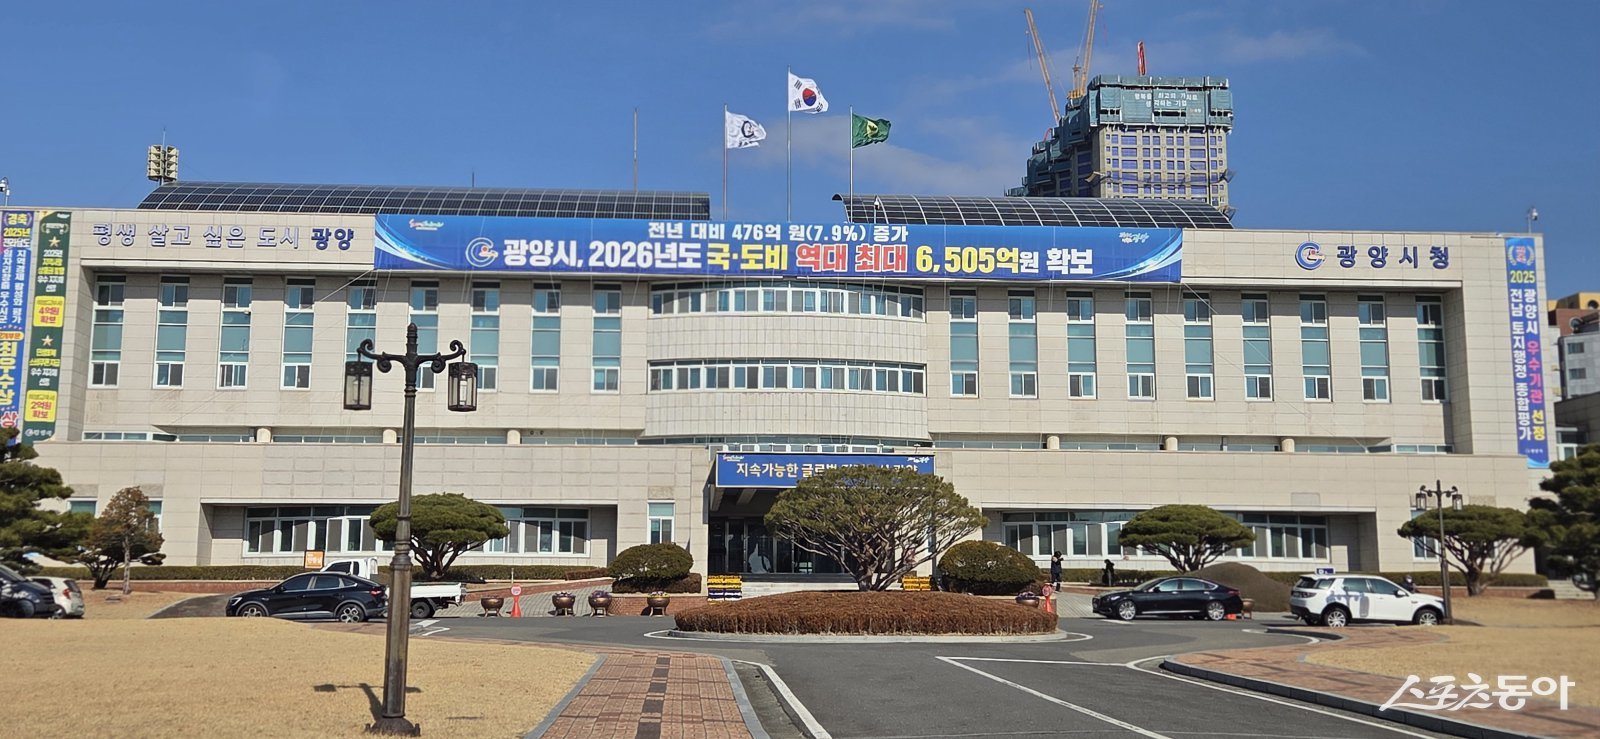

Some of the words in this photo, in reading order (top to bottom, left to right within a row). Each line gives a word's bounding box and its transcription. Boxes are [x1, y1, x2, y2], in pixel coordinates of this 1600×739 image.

[8, 213, 28, 225] 경축
[648, 222, 683, 239] 전년
[691, 223, 725, 240] 대비
[732, 224, 781, 241] 476억
[788, 225, 866, 242] 원(7.9%)
[873, 226, 908, 243] 증가
[92, 223, 137, 246] 평생
[148, 224, 191, 247] 살고
[203, 225, 246, 248] 싶은
[256, 226, 299, 249] 도시
[311, 227, 355, 251] 광양
[503, 239, 584, 268] 광양시,
[589, 240, 701, 269] 2026년도
[707, 243, 788, 271] 국·도비
[795, 243, 848, 272] 역대
[854, 244, 908, 273] 최대
[915, 245, 1039, 274] 6,505억원
[1046, 248, 1094, 275] 확보
[1337, 245, 1450, 270] 광양시청
[1510, 270, 1536, 283] 2025
[1510, 288, 1523, 317] 전남
[1524, 288, 1538, 334] 광양시
[1512, 321, 1527, 379] 토지행정
[0, 341, 18, 406] 최우수상
[1527, 340, 1543, 404] 우수기관
[1516, 382, 1532, 441] 종합평가
[1532, 409, 1546, 441] 선정
[736, 462, 798, 478] 지속가능한
